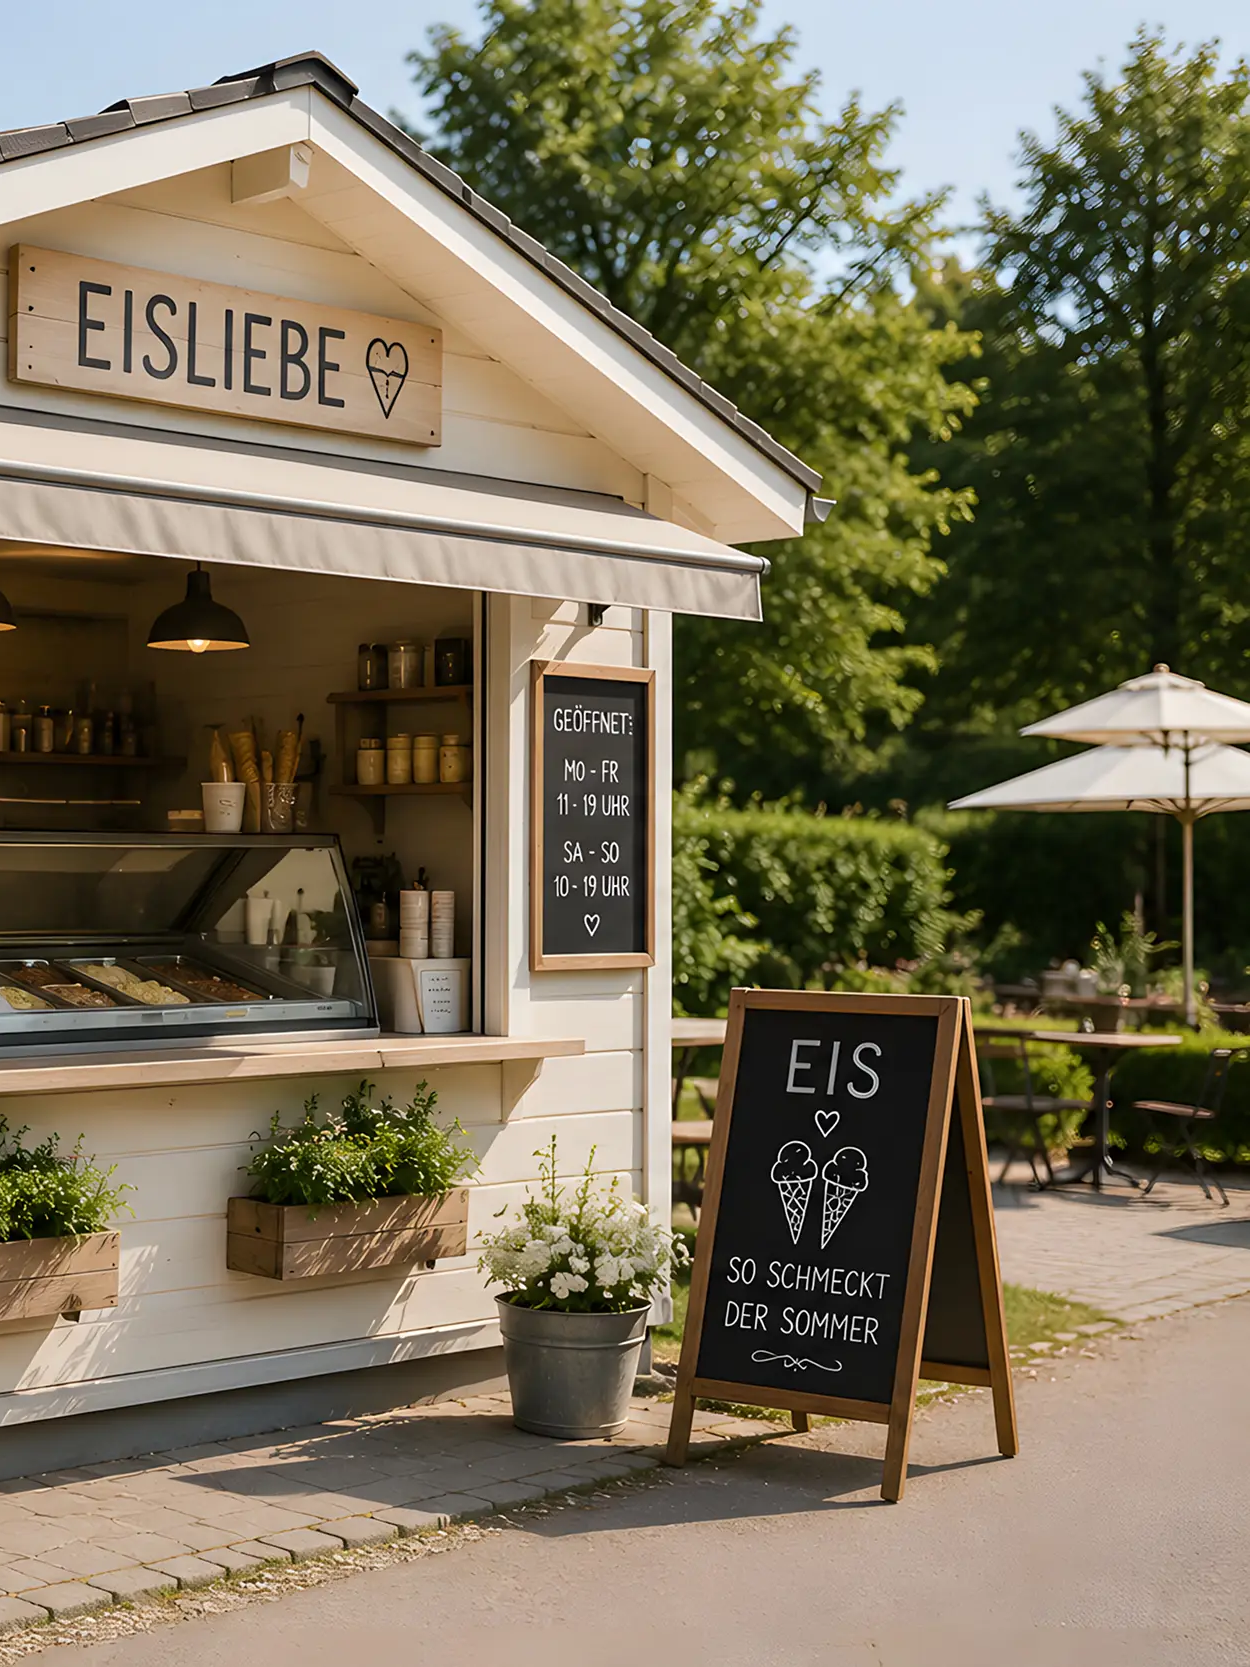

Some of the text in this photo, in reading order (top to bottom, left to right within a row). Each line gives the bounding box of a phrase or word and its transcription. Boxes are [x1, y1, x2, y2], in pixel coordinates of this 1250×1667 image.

[77, 280, 346, 409] EISLIEBE
[563, 758, 586, 782] MO
[601, 759, 620, 783] FR
[556, 792, 569, 816] 11
[582, 793, 597, 817] 19
[601, 794, 631, 817] UHR
[563, 840, 584, 864] SA
[600, 840, 620, 864] SO
[553, 874, 569, 898] 10
[582, 874, 597, 898] 19
[601, 874, 631, 898] UHR
[786, 1039, 882, 1099] EIS
[726, 1256, 891, 1300] SO SCHMECKT
[724, 1300, 879, 1346] DER SOMMER
